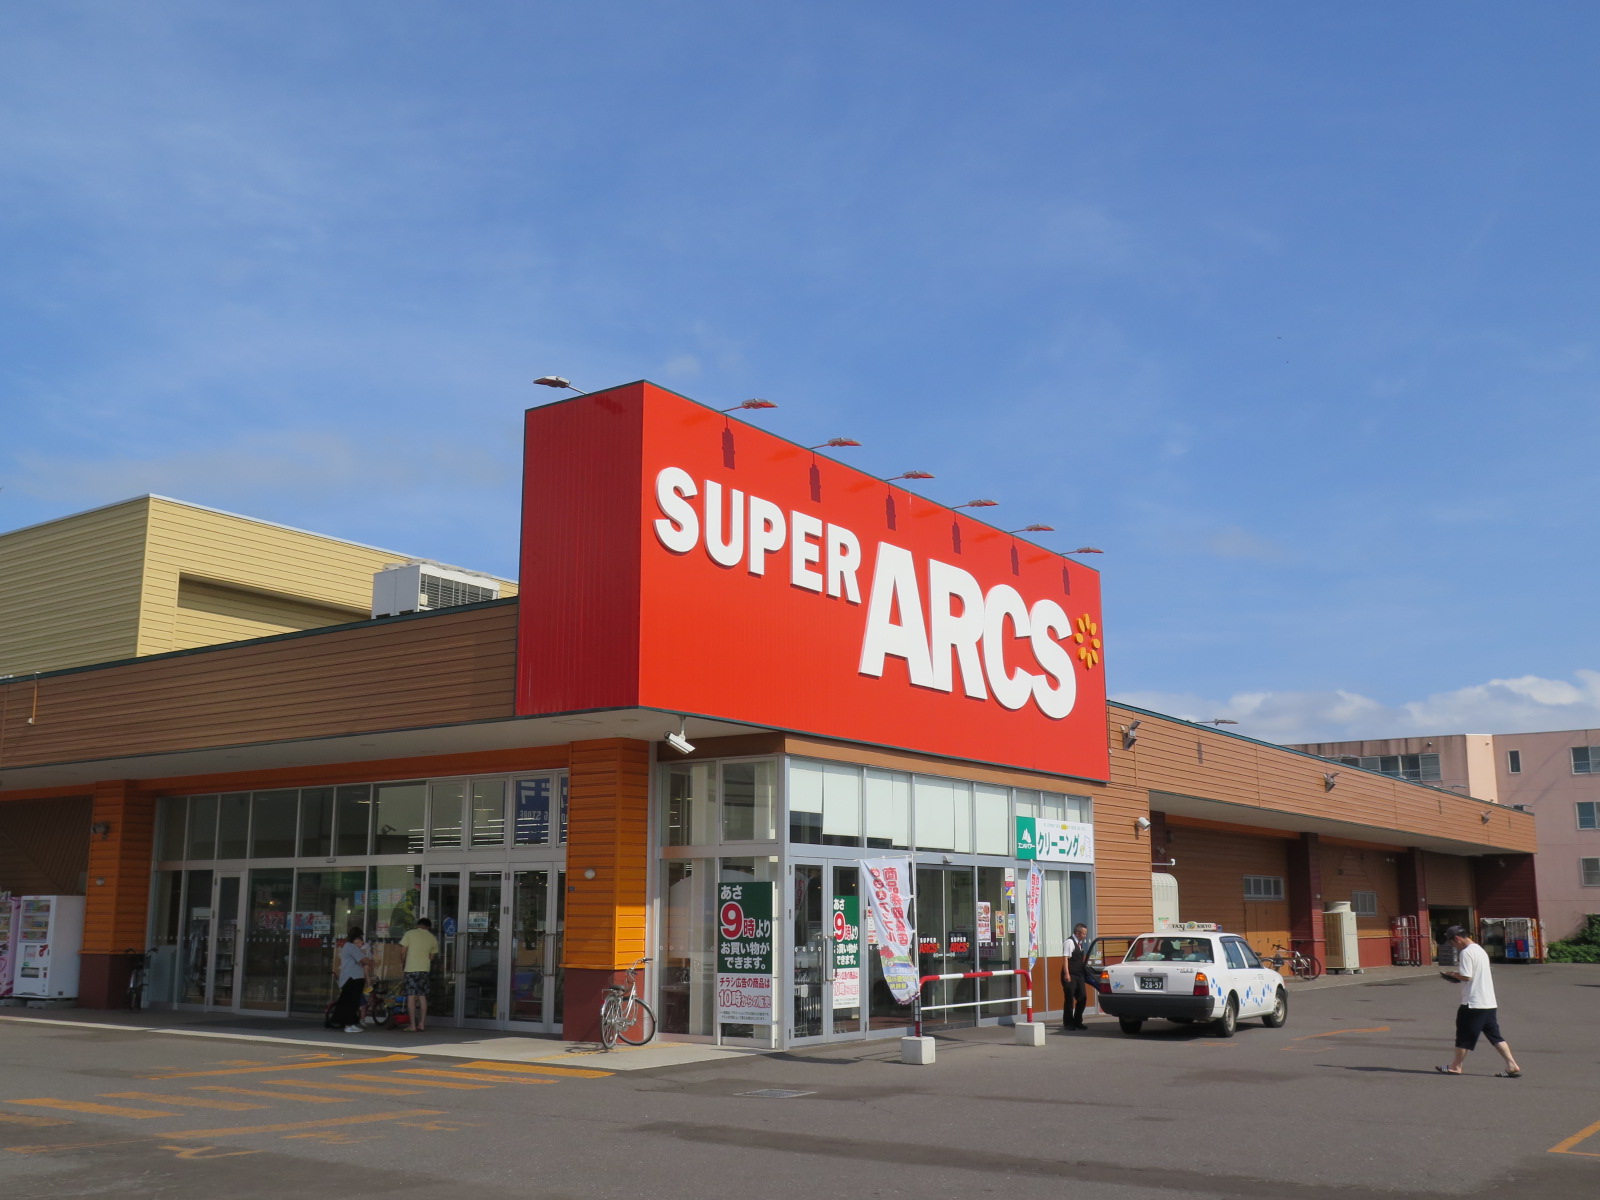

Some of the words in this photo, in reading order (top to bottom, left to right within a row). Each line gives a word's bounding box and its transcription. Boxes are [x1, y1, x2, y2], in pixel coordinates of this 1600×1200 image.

[653, 466, 861, 604] SUPER
[858, 541, 1077, 719] ARCS
[1038, 831, 1080, 857] クリーニング
[720, 885, 743, 900] あさ
[833, 898, 845, 910] あさ
[720, 901, 771, 940] 9時より
[720, 941, 771, 955] お買い物が
[919, 943, 937, 953] ARCS
[724, 956, 766, 970] できます。
[719, 977, 771, 989] チラシ広告の商品は
[719, 989, 771, 1008] 10時からの販売
